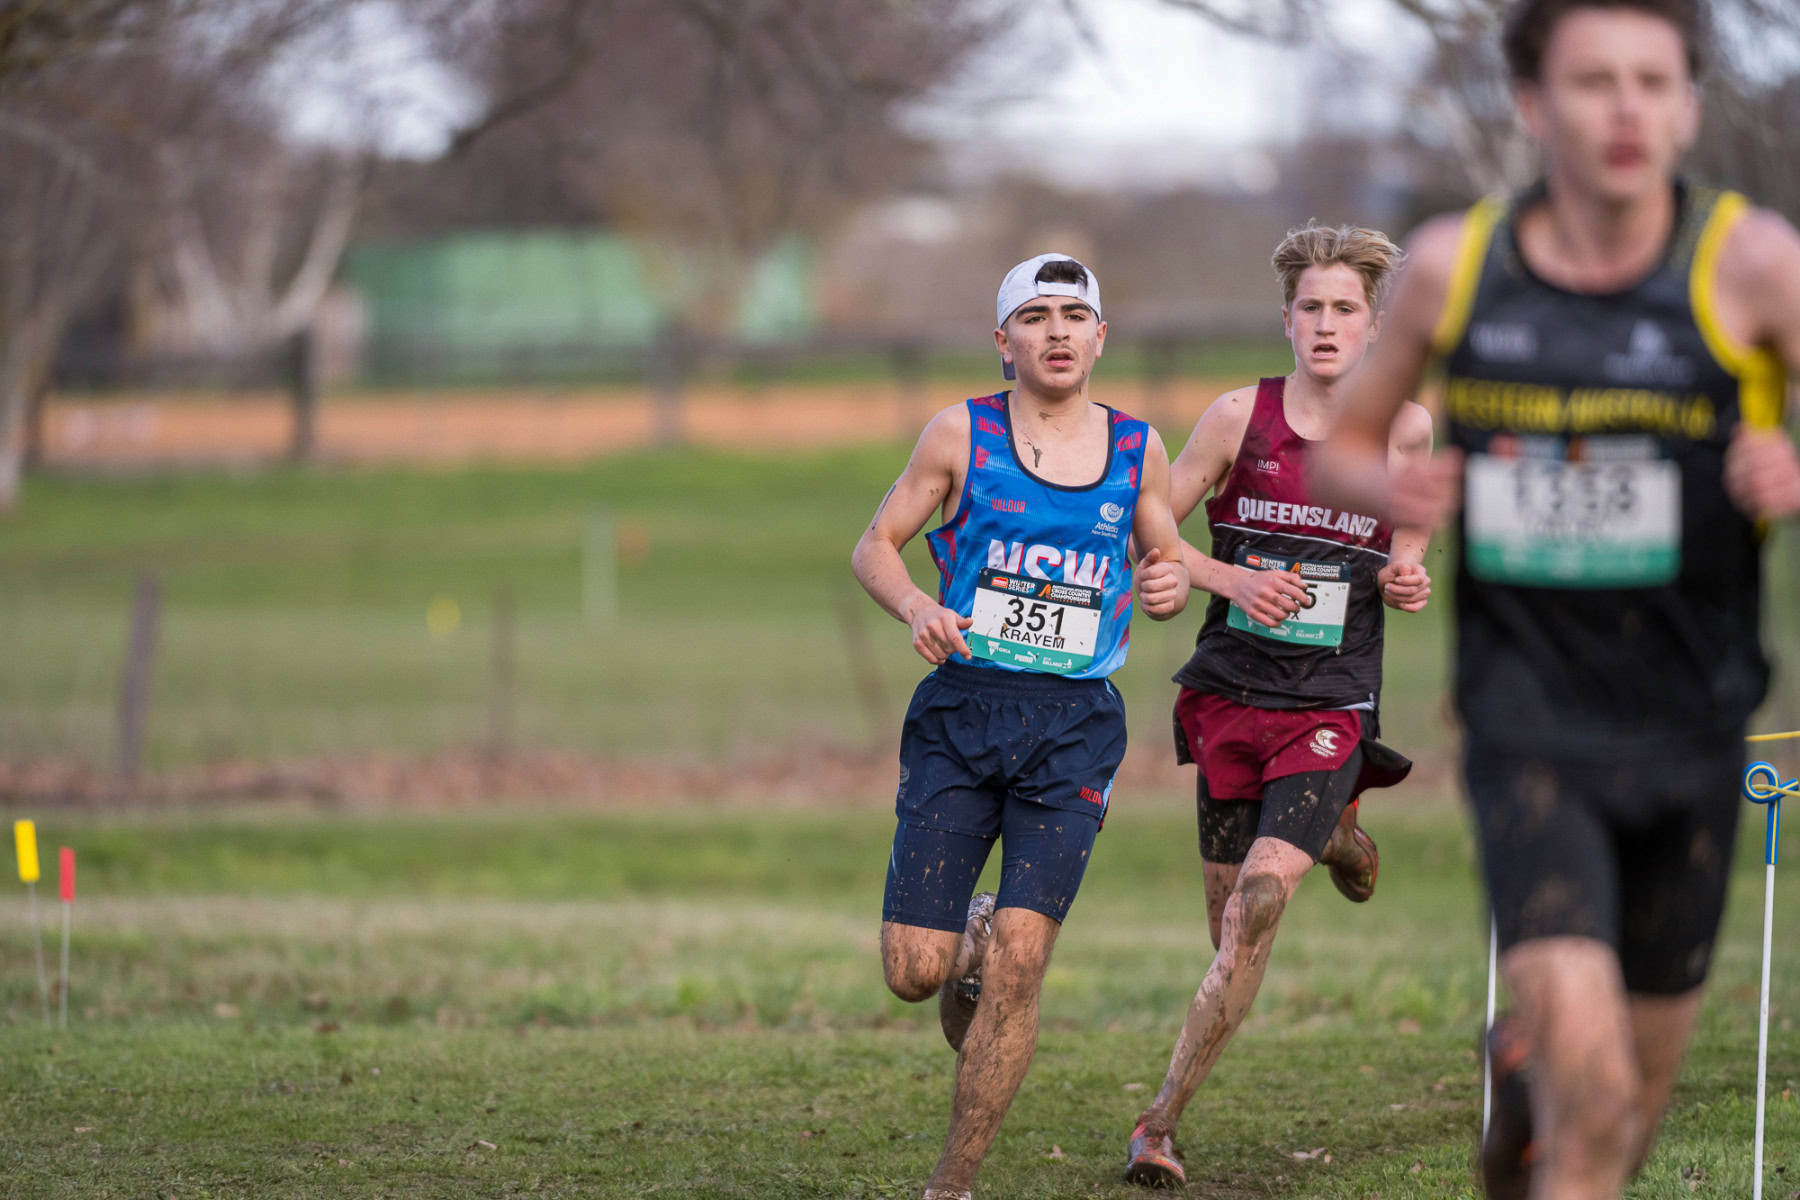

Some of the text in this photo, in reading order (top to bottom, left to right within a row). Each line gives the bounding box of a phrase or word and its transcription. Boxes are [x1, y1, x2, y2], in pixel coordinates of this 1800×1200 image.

[1257, 459, 1280, 471] IMPI
[991, 498, 1026, 514] VALOUR
[1237, 496, 1378, 538] QUEENSLAND
[1094, 521, 1119, 534] Athletics
[987, 538, 1110, 591] NSW
[1261, 556, 1286, 567] WINTER
[1300, 570, 1339, 578] CHAMPIONSHIPS
[1008, 584, 1030, 594] SERIES
[1009, 578, 1036, 590] WINTER
[1051, 588, 1091, 598] CROSS COUNTRY
[1051, 592, 1091, 603] CHAMPIONSHIPS
[1004, 598, 1065, 636] 351
[1000, 626, 1065, 650] KRAYEM
